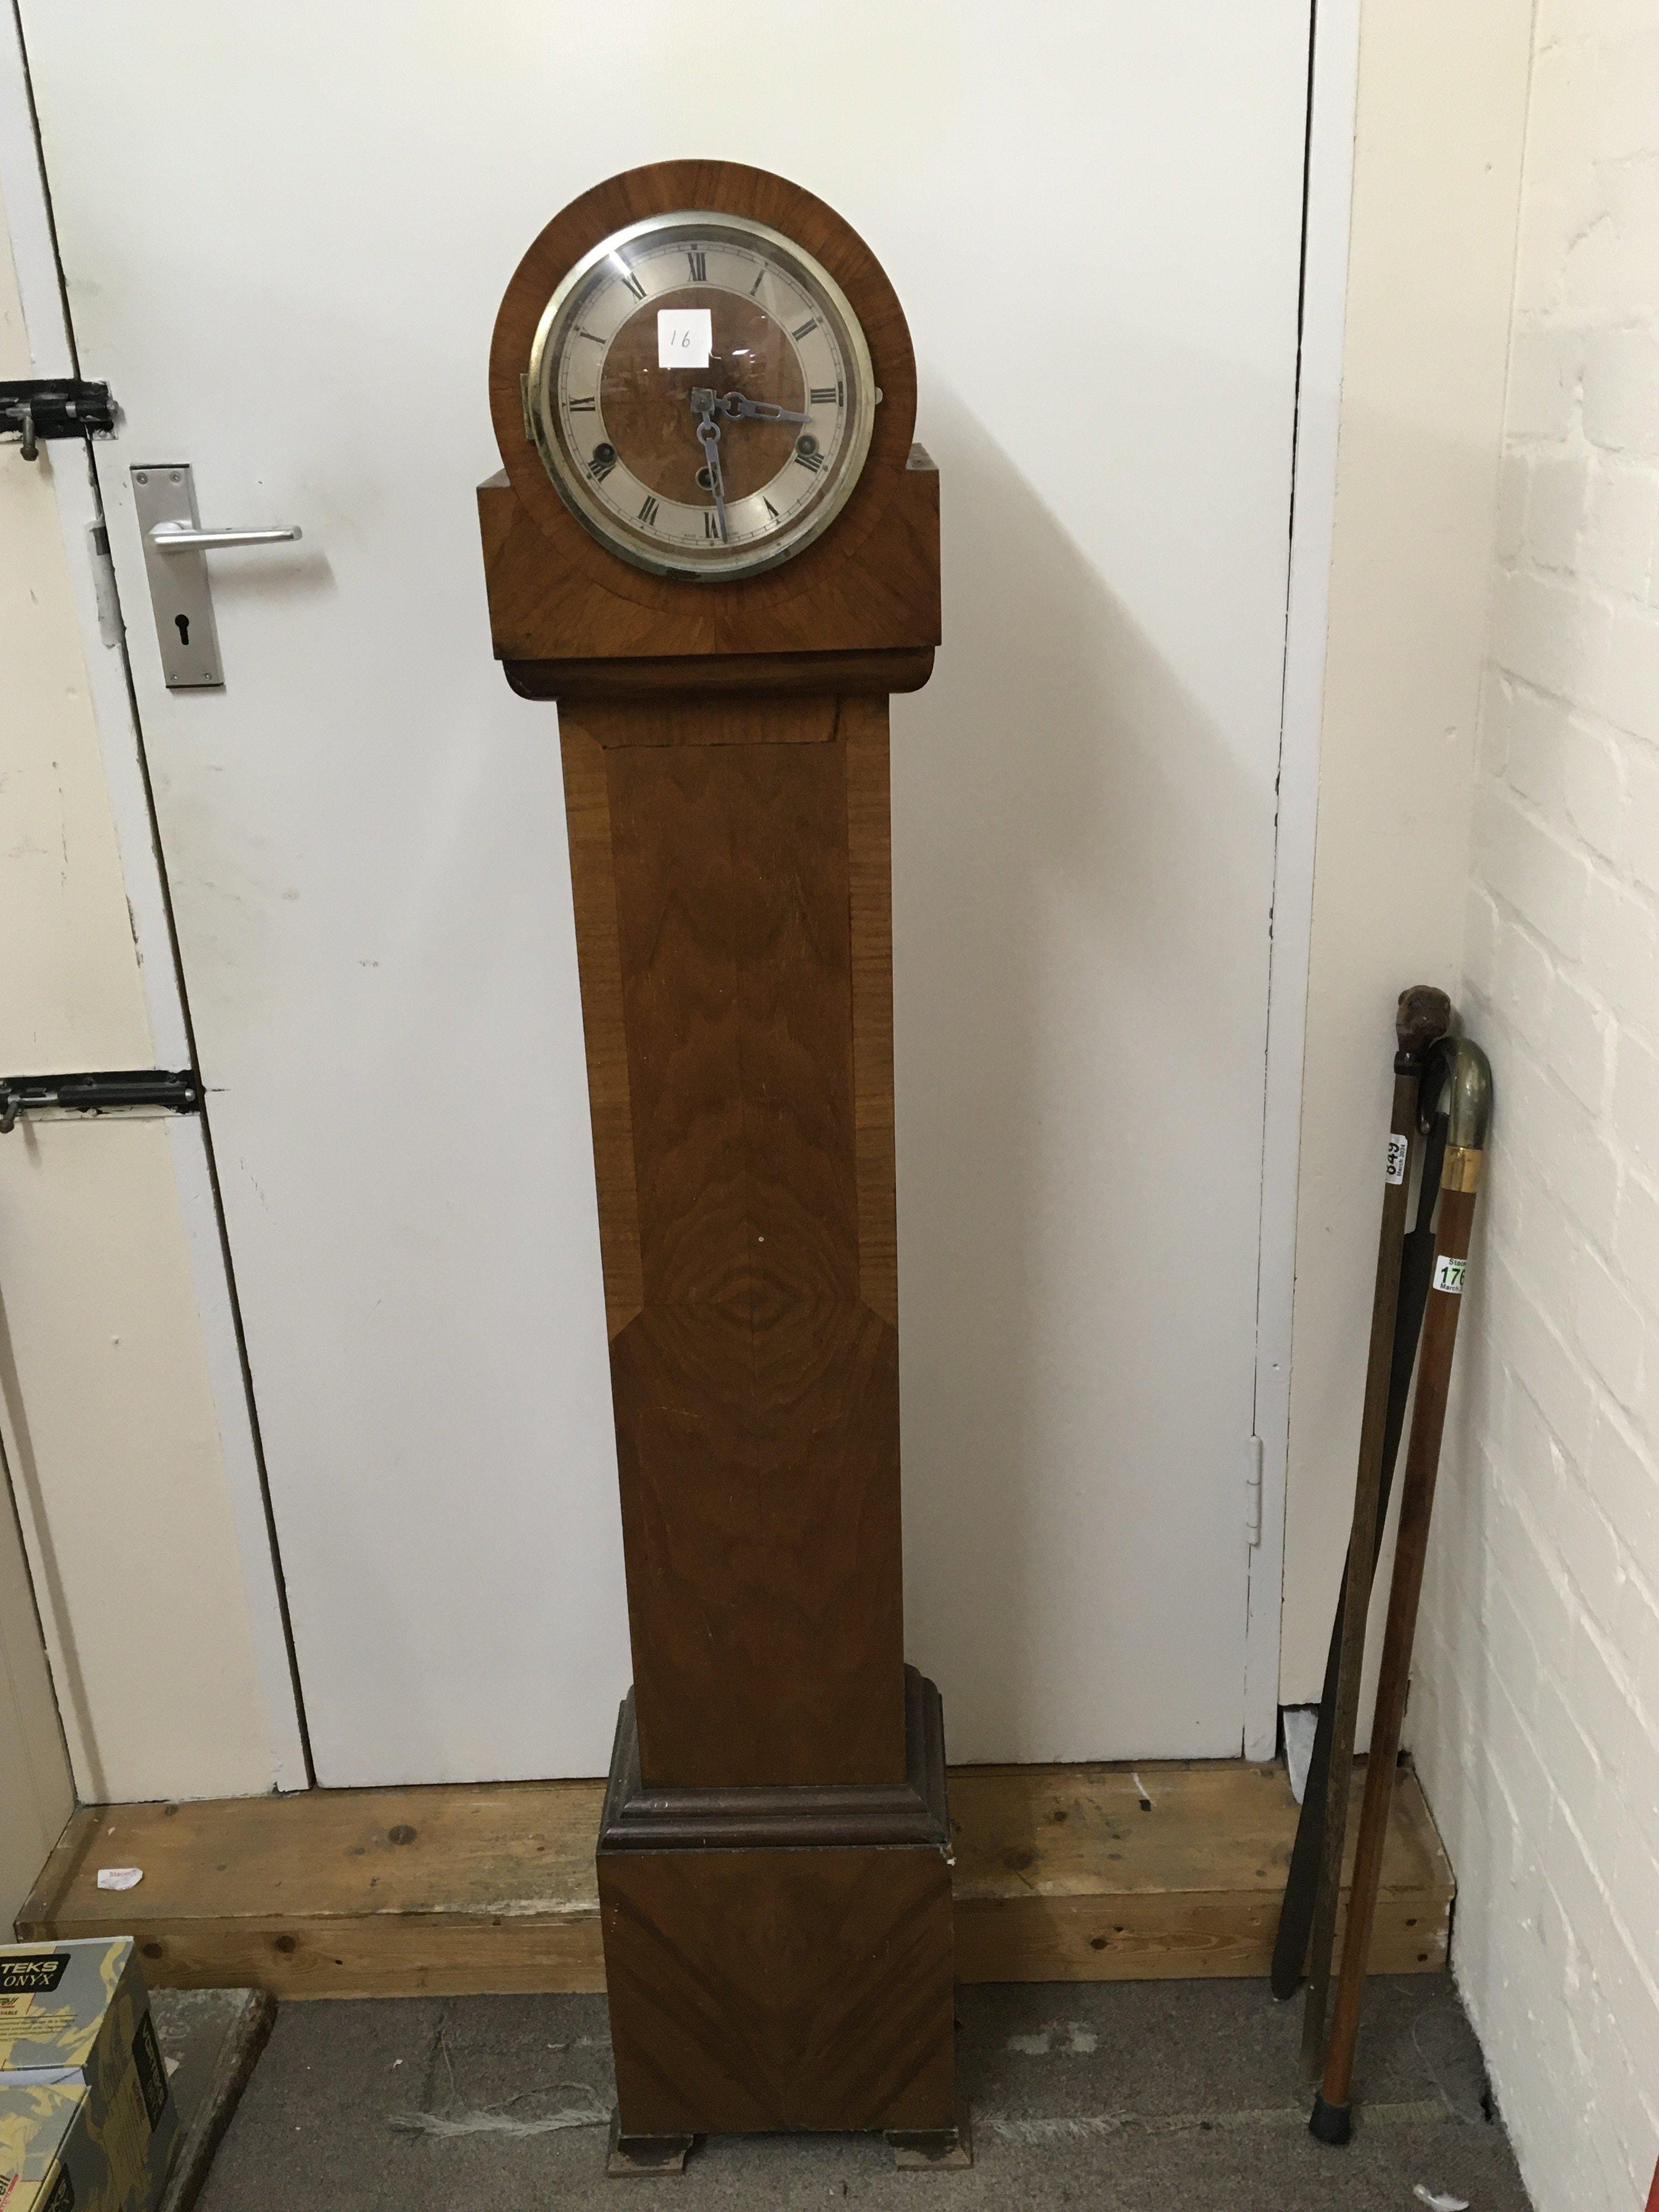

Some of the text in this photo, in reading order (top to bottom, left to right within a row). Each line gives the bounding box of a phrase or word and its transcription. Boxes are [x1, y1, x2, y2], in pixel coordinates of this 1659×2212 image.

[687, 252, 707, 281] XII
[671, 330, 691, 348] 16
[810, 387, 837, 405] III
[1440, 1283, 1459, 1291] March
[1, 1961, 59, 1974] TEKS
[3, 1973, 54, 1987] ONYX
